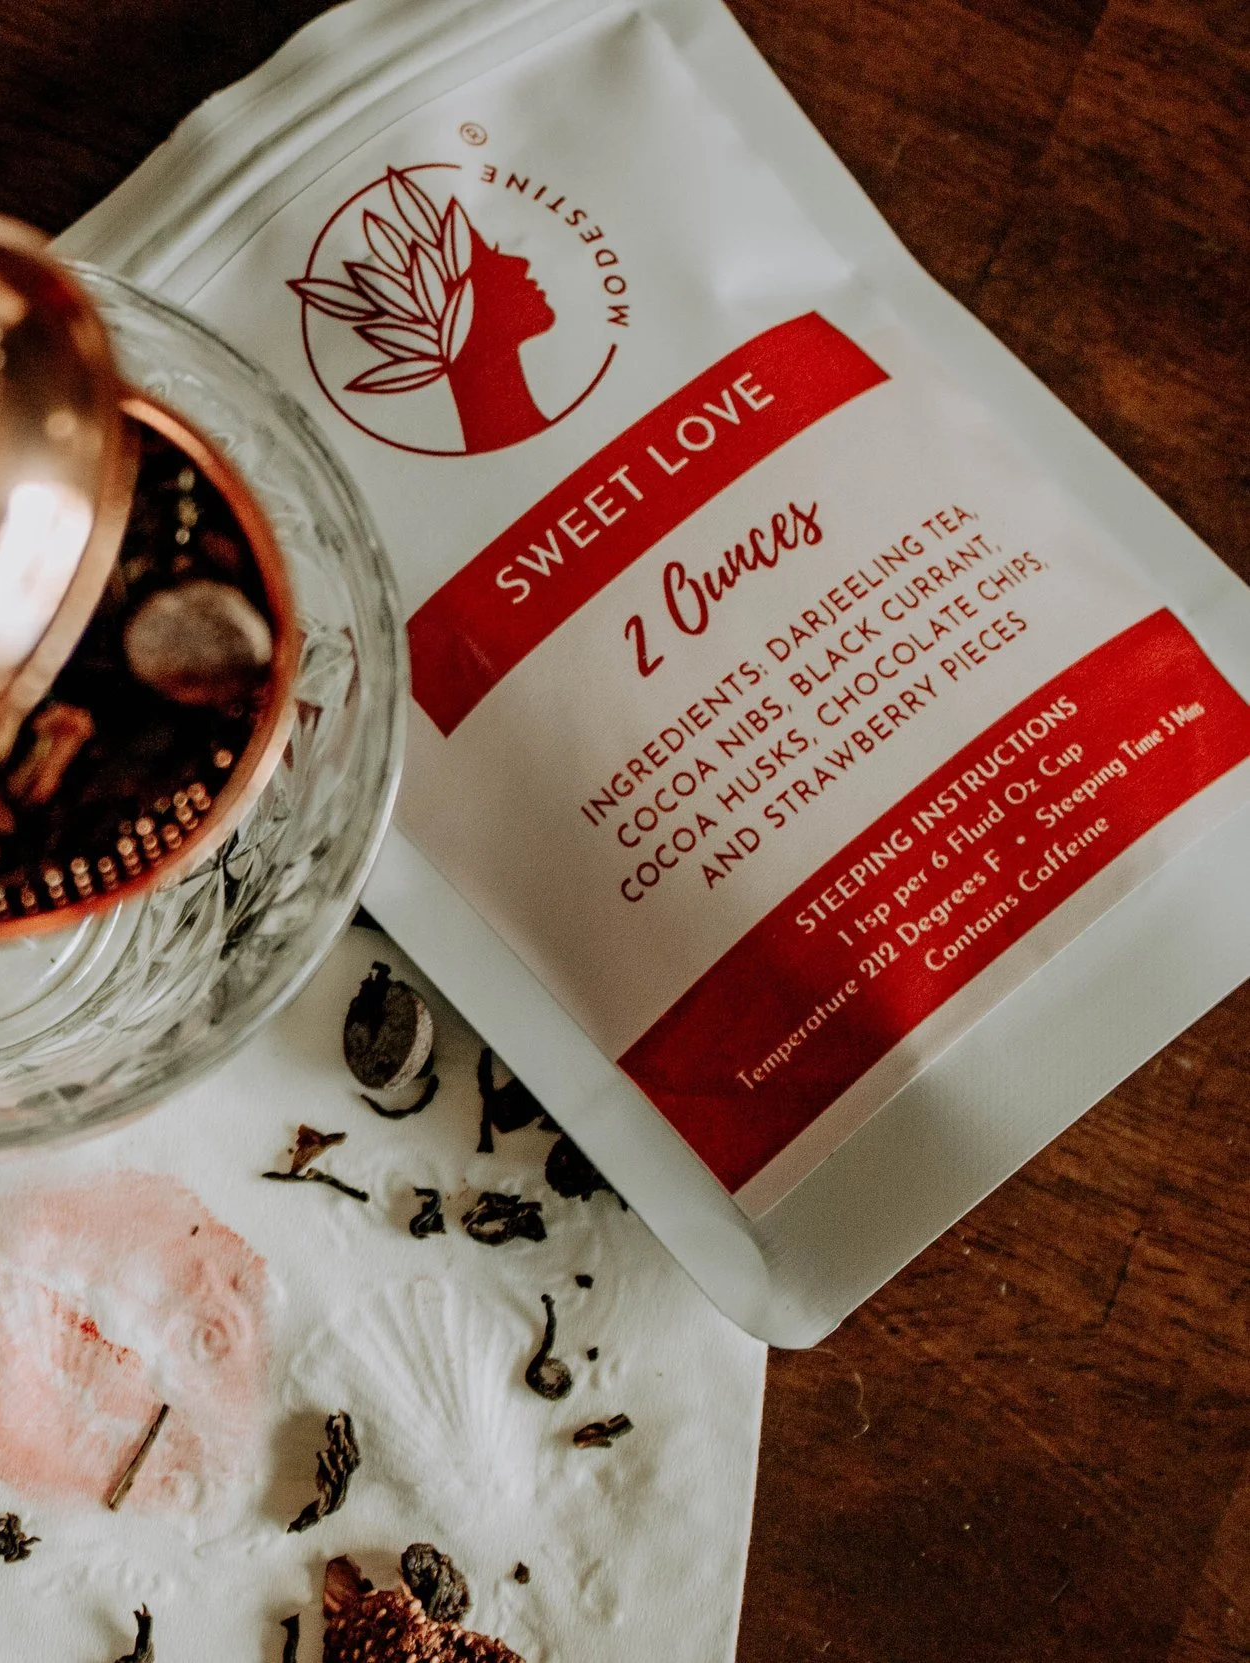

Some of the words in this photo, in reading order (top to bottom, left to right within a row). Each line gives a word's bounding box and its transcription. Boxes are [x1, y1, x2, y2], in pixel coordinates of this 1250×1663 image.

[480, 164, 630, 327] MODESTINE
[495, 464, 644, 604] SWEET
[646, 371, 775, 476] LOVE
[624, 614, 665, 678] 2
[662, 500, 823, 636] Ounces
[580, 661, 769, 827] INGREDIENTS:
[765, 534, 924, 663] DARJEELING
[921, 504, 979, 540] TEA,
[617, 758, 718, 848] COCOA
[715, 696, 792, 759] NIBS,
[788, 616, 882, 697] BLACK
[881, 533, 1002, 622] CURRANT,
[620, 813, 718, 903] COCOA
[716, 728, 819, 813] HUSKS,
[816, 594, 979, 727] CHOCOLATE
[977, 551, 1050, 601] CHIPS,
[701, 826, 761, 890] AND
[763, 673, 938, 829] STRAWBERRY
[939, 610, 1028, 682] PIECES
[735, 978, 860, 1090] Temperature
[858, 941, 901, 979] 212
[895, 871, 988, 947] Degrees
[983, 848, 1001, 873] F
[1035, 758, 1128, 829] Steeping
[1118, 729, 1165, 761] Time
[795, 828, 914, 935] STEEPING
[910, 695, 1078, 835] INSTRUCTIONS
[836, 929, 854, 947] 1
[853, 902, 891, 934] tsp
[892, 868, 929, 908] per
[931, 850, 949, 870] 6
[946, 799, 1006, 855] Fluid
[1004, 778, 1042, 805] Oz
[1038, 743, 1084, 777] Cup
[924, 894, 1019, 972] Contains
[1017, 816, 1110, 893] Caffeine
